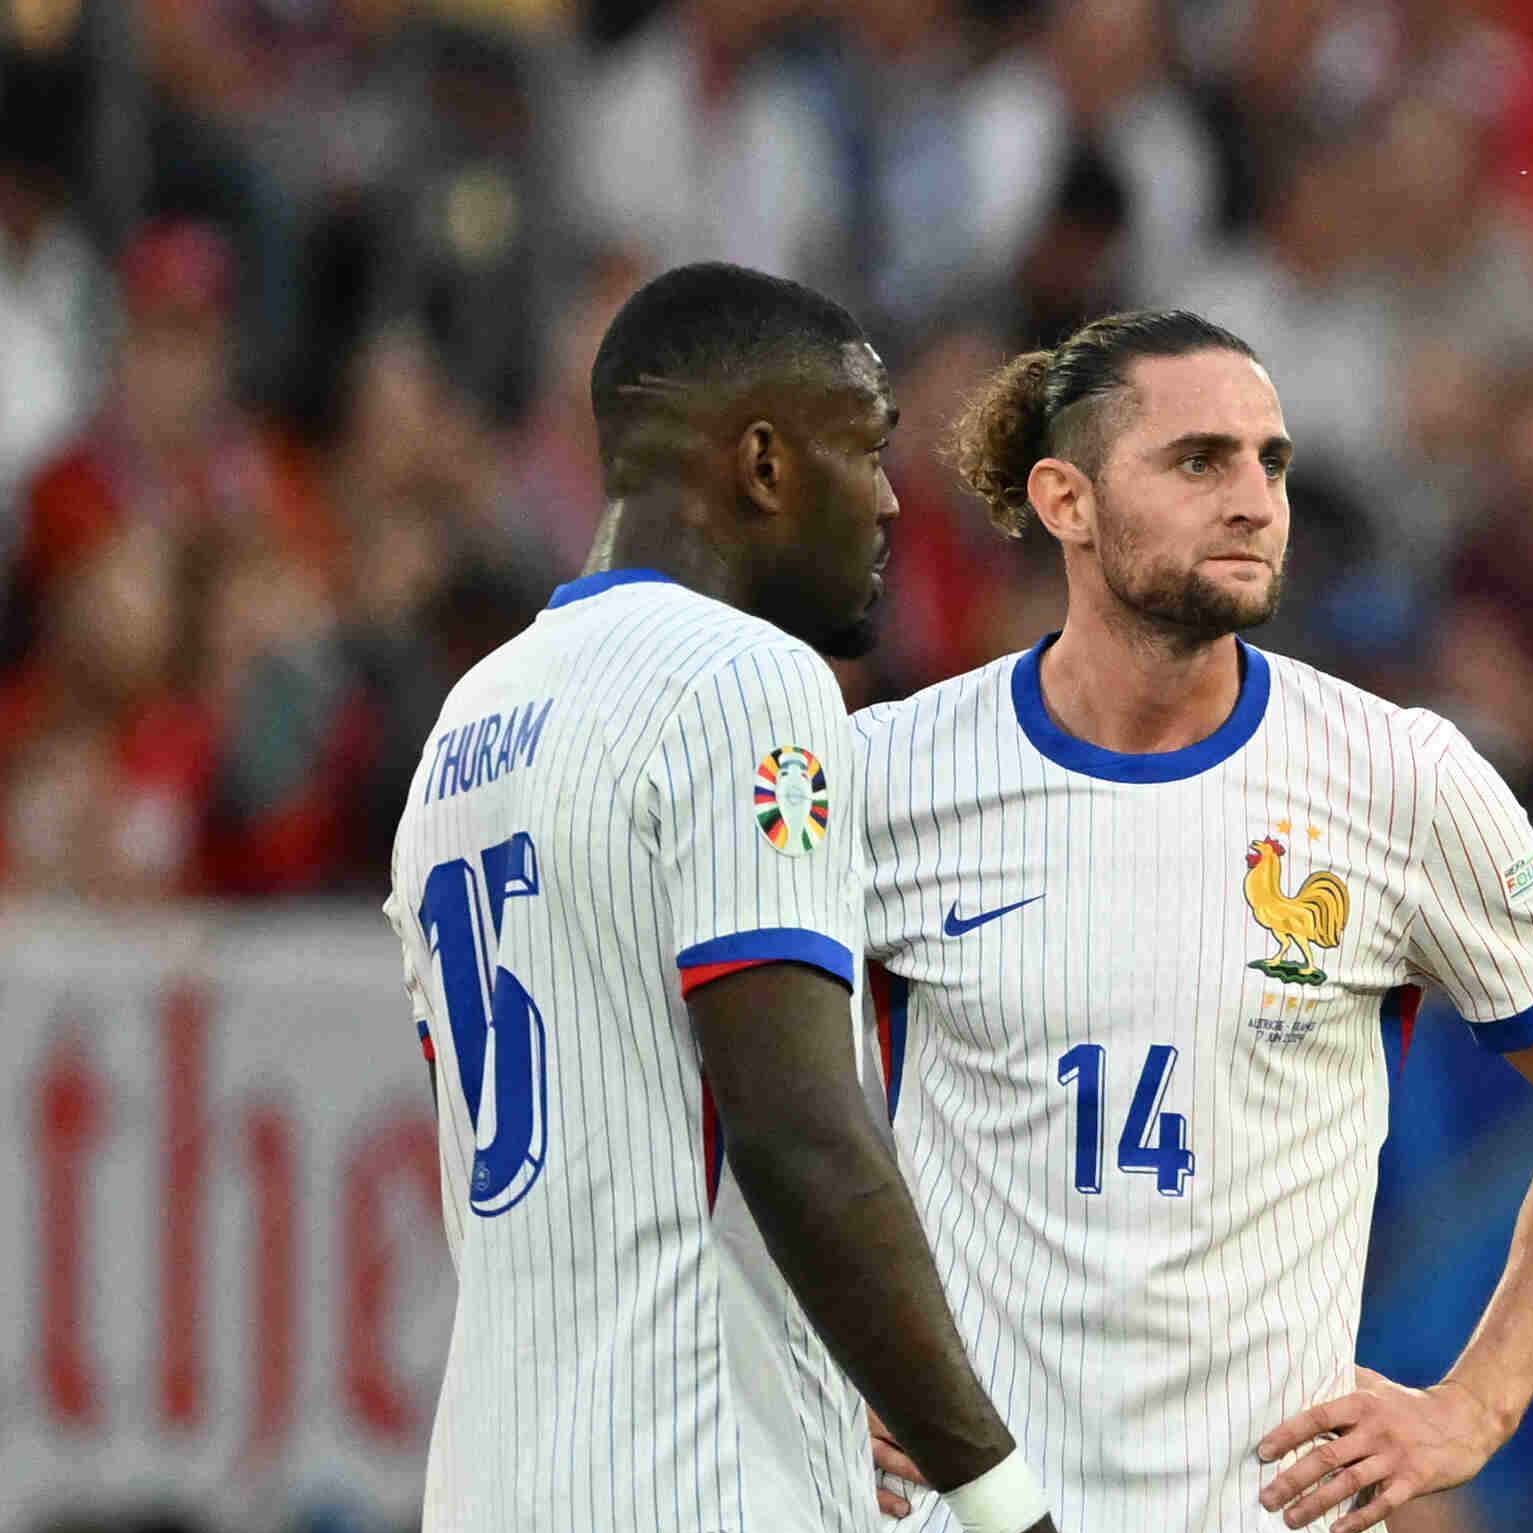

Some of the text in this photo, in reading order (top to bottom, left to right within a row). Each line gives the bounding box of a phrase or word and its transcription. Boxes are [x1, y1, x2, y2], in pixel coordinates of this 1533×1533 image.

[424, 697, 554, 805] THURAM
[418, 832, 547, 1217] 15
[1058, 1044, 1195, 1197] 14
